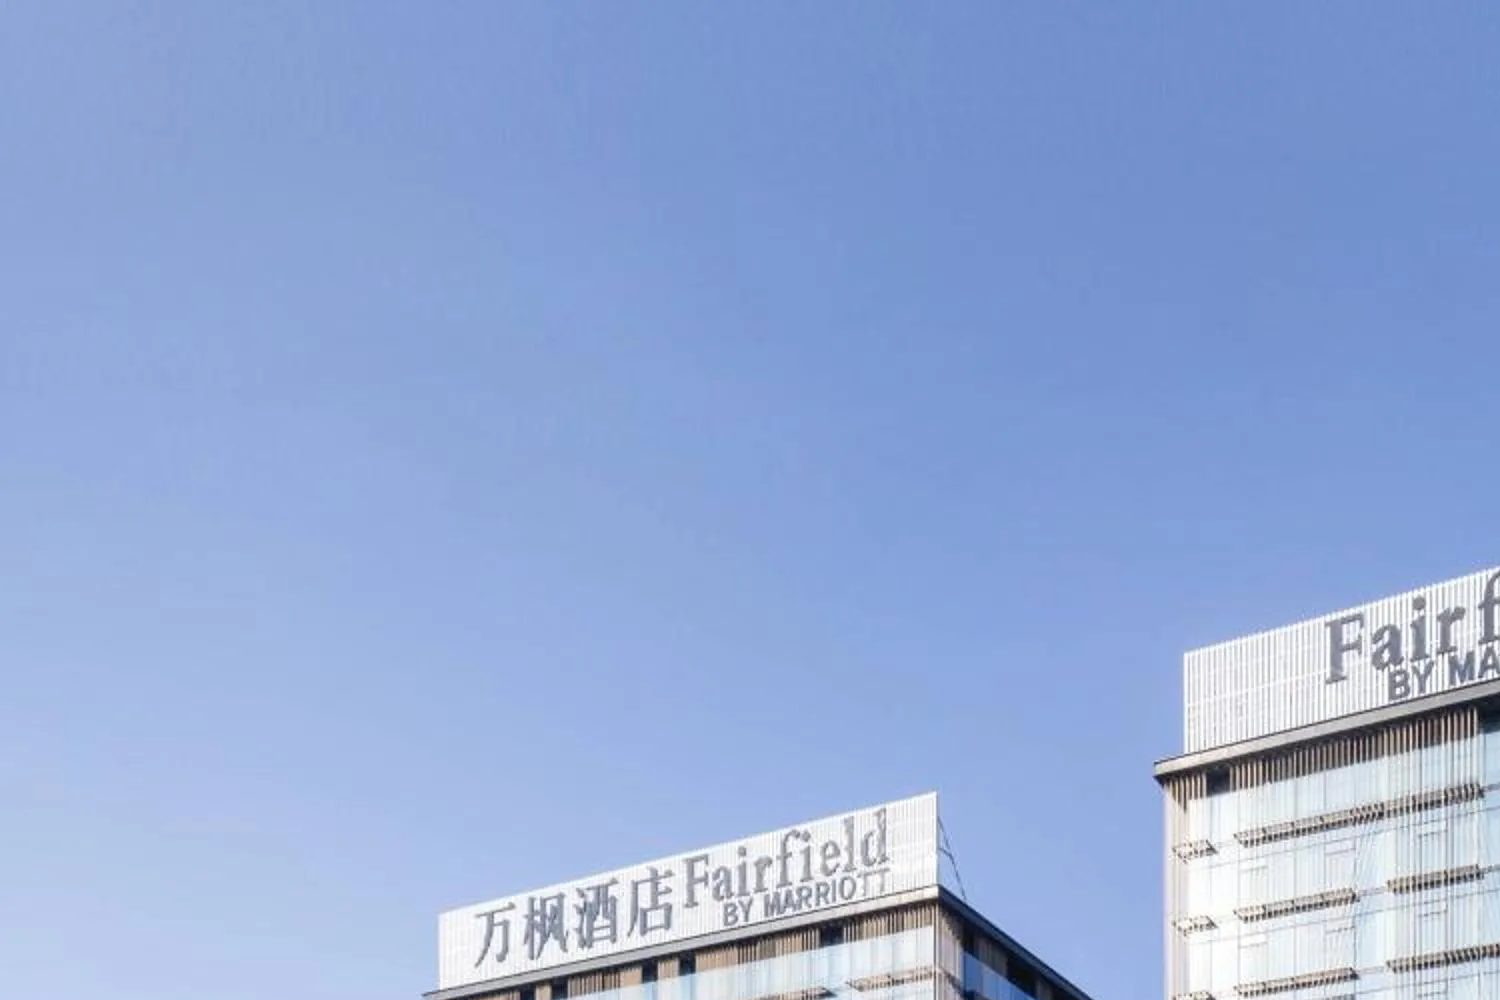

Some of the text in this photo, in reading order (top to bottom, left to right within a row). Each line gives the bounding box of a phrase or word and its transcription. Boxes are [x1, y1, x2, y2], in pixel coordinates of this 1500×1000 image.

[1388, 660, 1435, 701] BY
[474, 808, 890, 969] 万枫酒店 Fairfield
[723, 867, 891, 927] BY MARRIOTT
